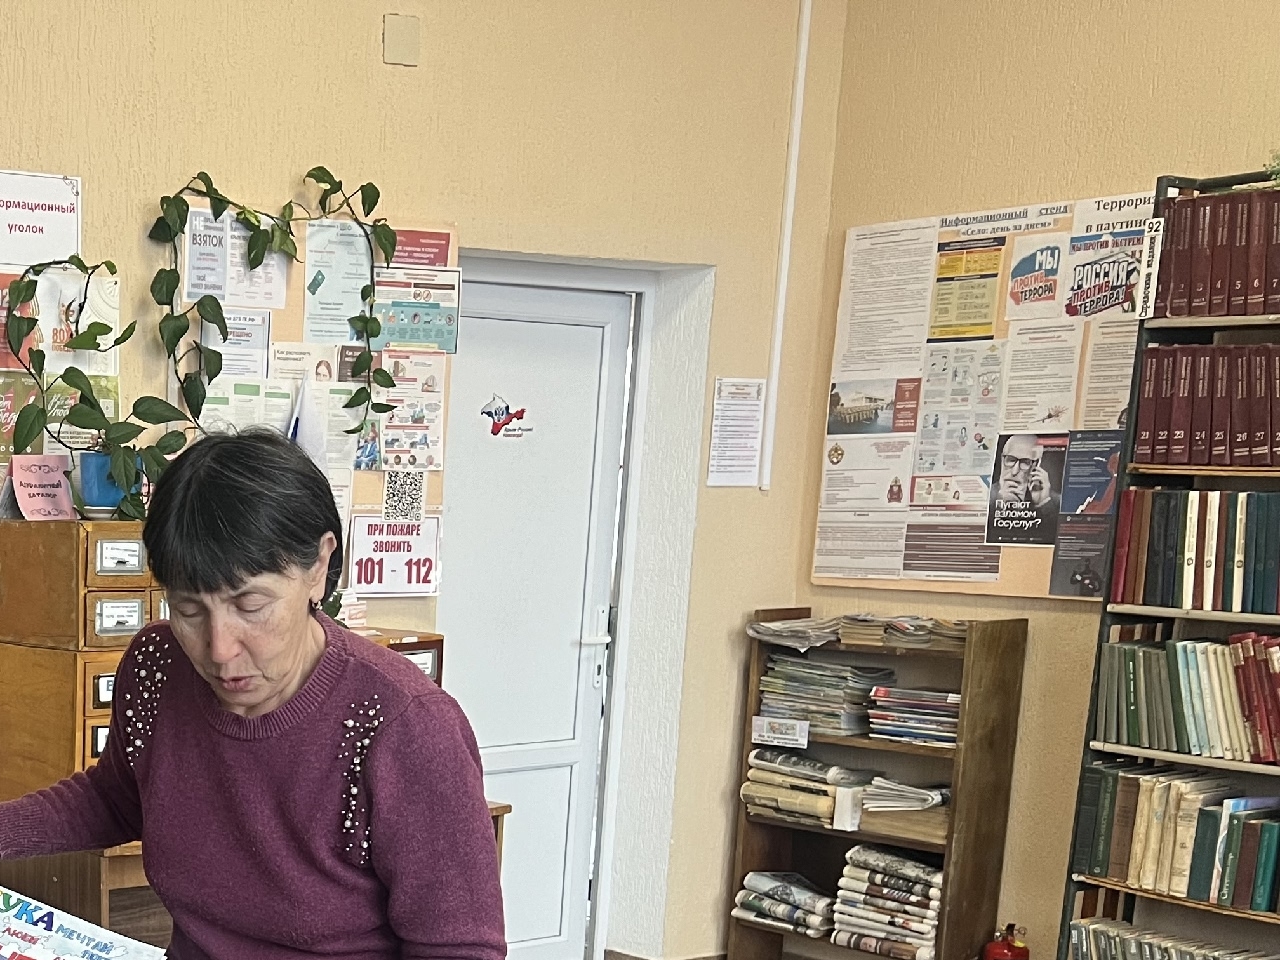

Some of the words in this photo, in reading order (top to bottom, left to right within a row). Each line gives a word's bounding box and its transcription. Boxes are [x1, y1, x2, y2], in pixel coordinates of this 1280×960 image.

[940, 208, 1028, 227] Информационный
[1039, 204, 1068, 216] стенд
[7, 223, 44, 234] уголок
[192, 216, 205, 230] НЕ
[990, 225, 1010, 235] день
[1147, 220, 1161, 233] 92
[192, 233, 224, 248] ВЗЯТОК
[1036, 249, 1059, 270] МЫ
[1014, 270, 1045, 292] ПРОТИВ
[1073, 260, 1128, 289] РОССИЯ
[1020, 283, 1054, 300] ТЕРРОРА
[1072, 281, 1111, 303] ПРОТИВ
[1078, 287, 1125, 316] ТЕРРОРА!
[1173, 430, 1184, 439] 23
[1255, 431, 1265, 440] 27
[995, 499, 1031, 510] Пугают
[994, 510, 1037, 518] взломом
[367, 523, 385, 536] ПРИ
[386, 523, 421, 536] ПОЖАРЕ
[993, 518, 1042, 530] Госуслуг?
[372, 540, 412, 552] ЗВОНИТЬ
[355, 557, 384, 585] 101
[404, 557, 433, 584] 112
[55, 924, 115, 955] МЕЧТАЙ
